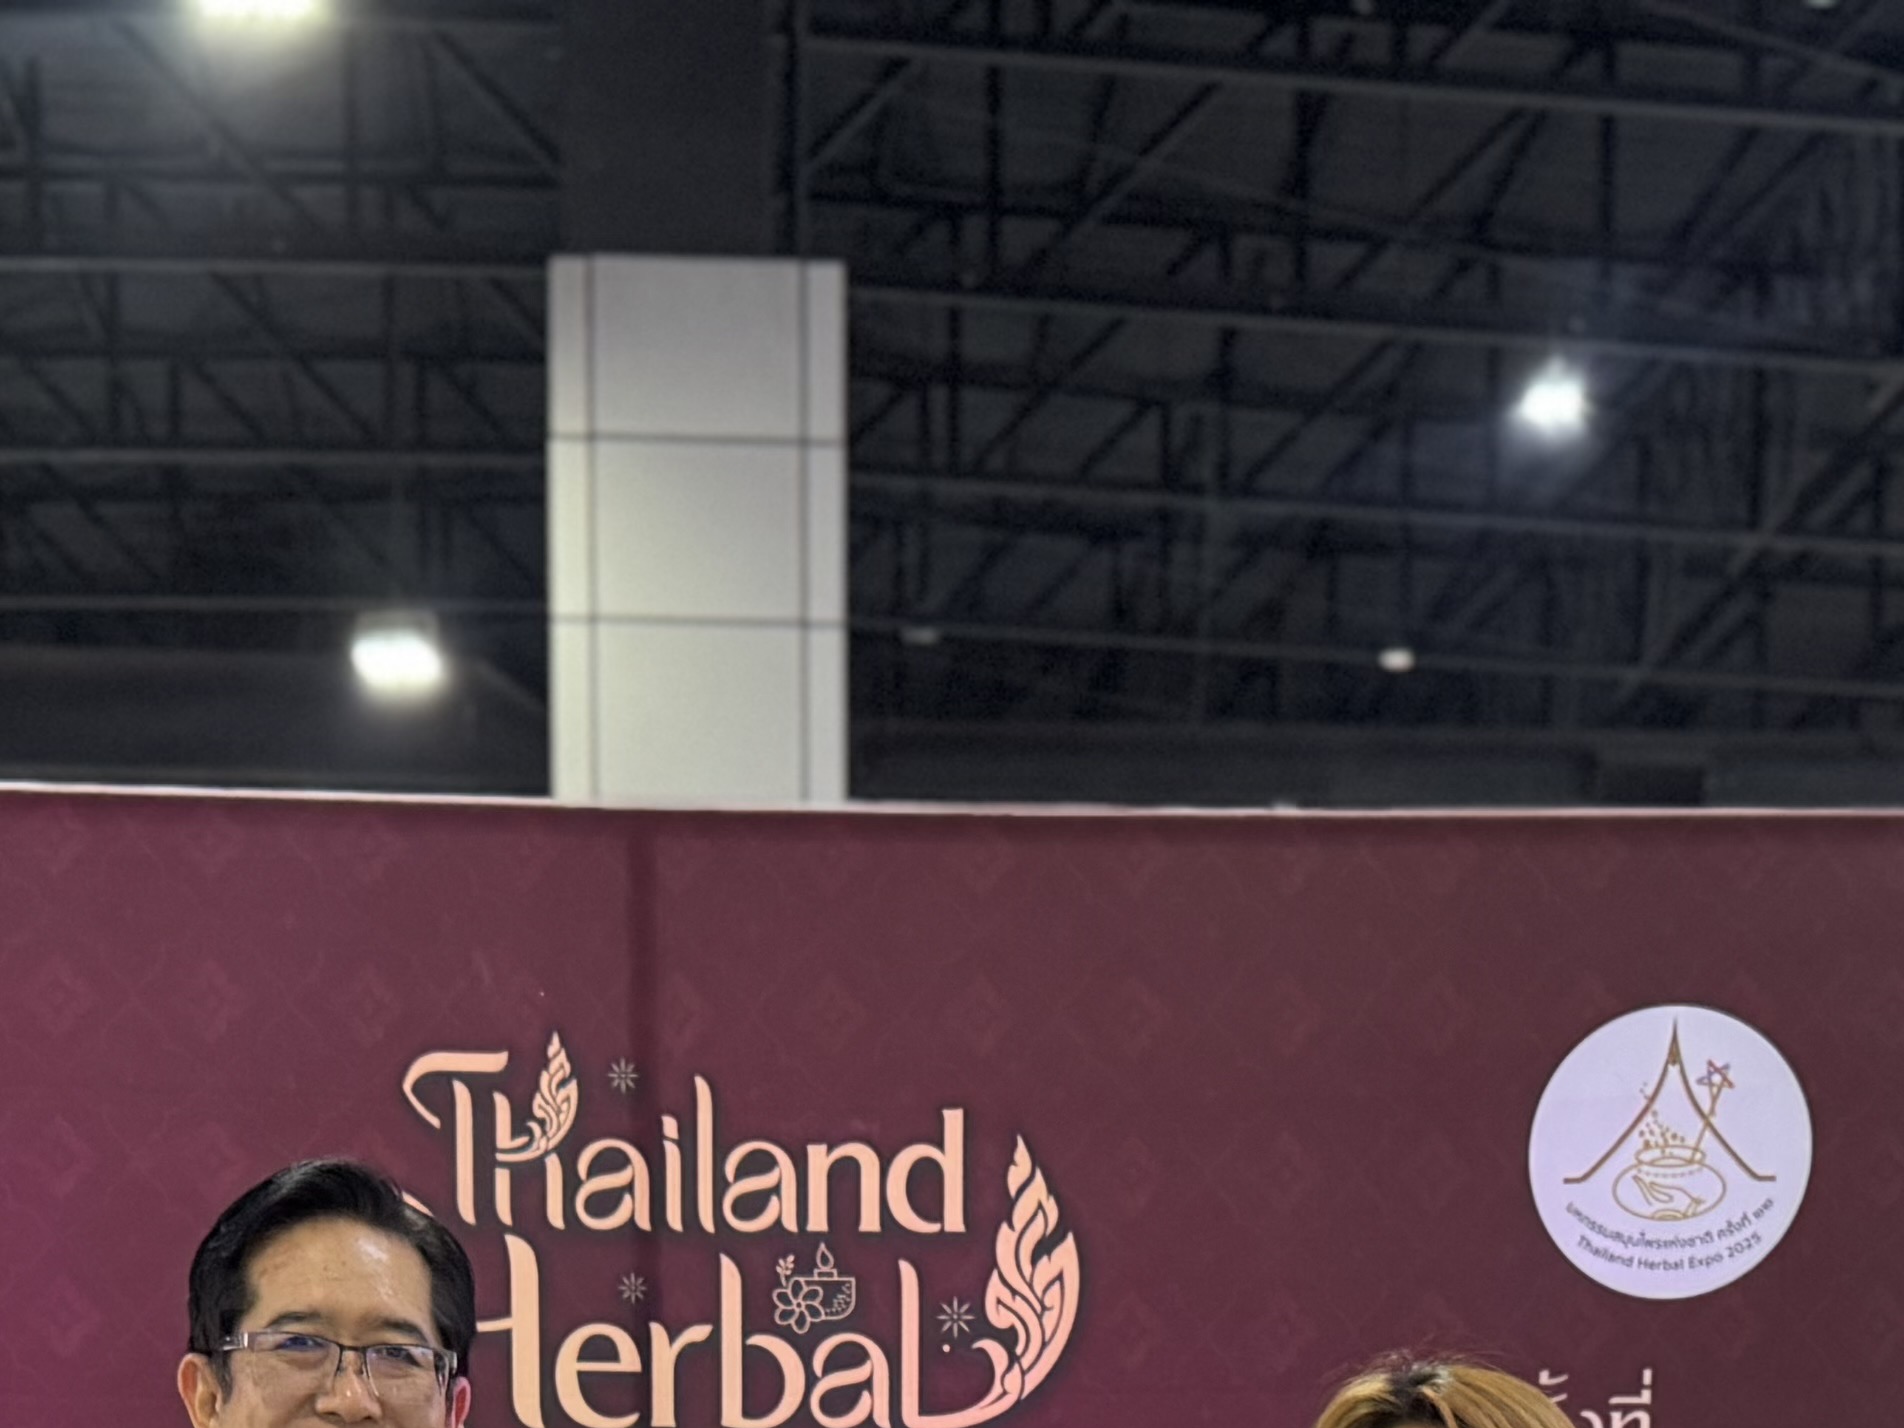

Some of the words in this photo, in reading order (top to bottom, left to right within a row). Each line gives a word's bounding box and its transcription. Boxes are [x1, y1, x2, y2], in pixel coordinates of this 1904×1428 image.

[401, 1031, 965, 1233] Thailand
[1577, 1235, 1633, 1268] Thailand
[1637, 1257, 1684, 1271] Herbal
[1688, 1252, 1723, 1269] Expo
[1727, 1232, 1762, 1258] 2025
